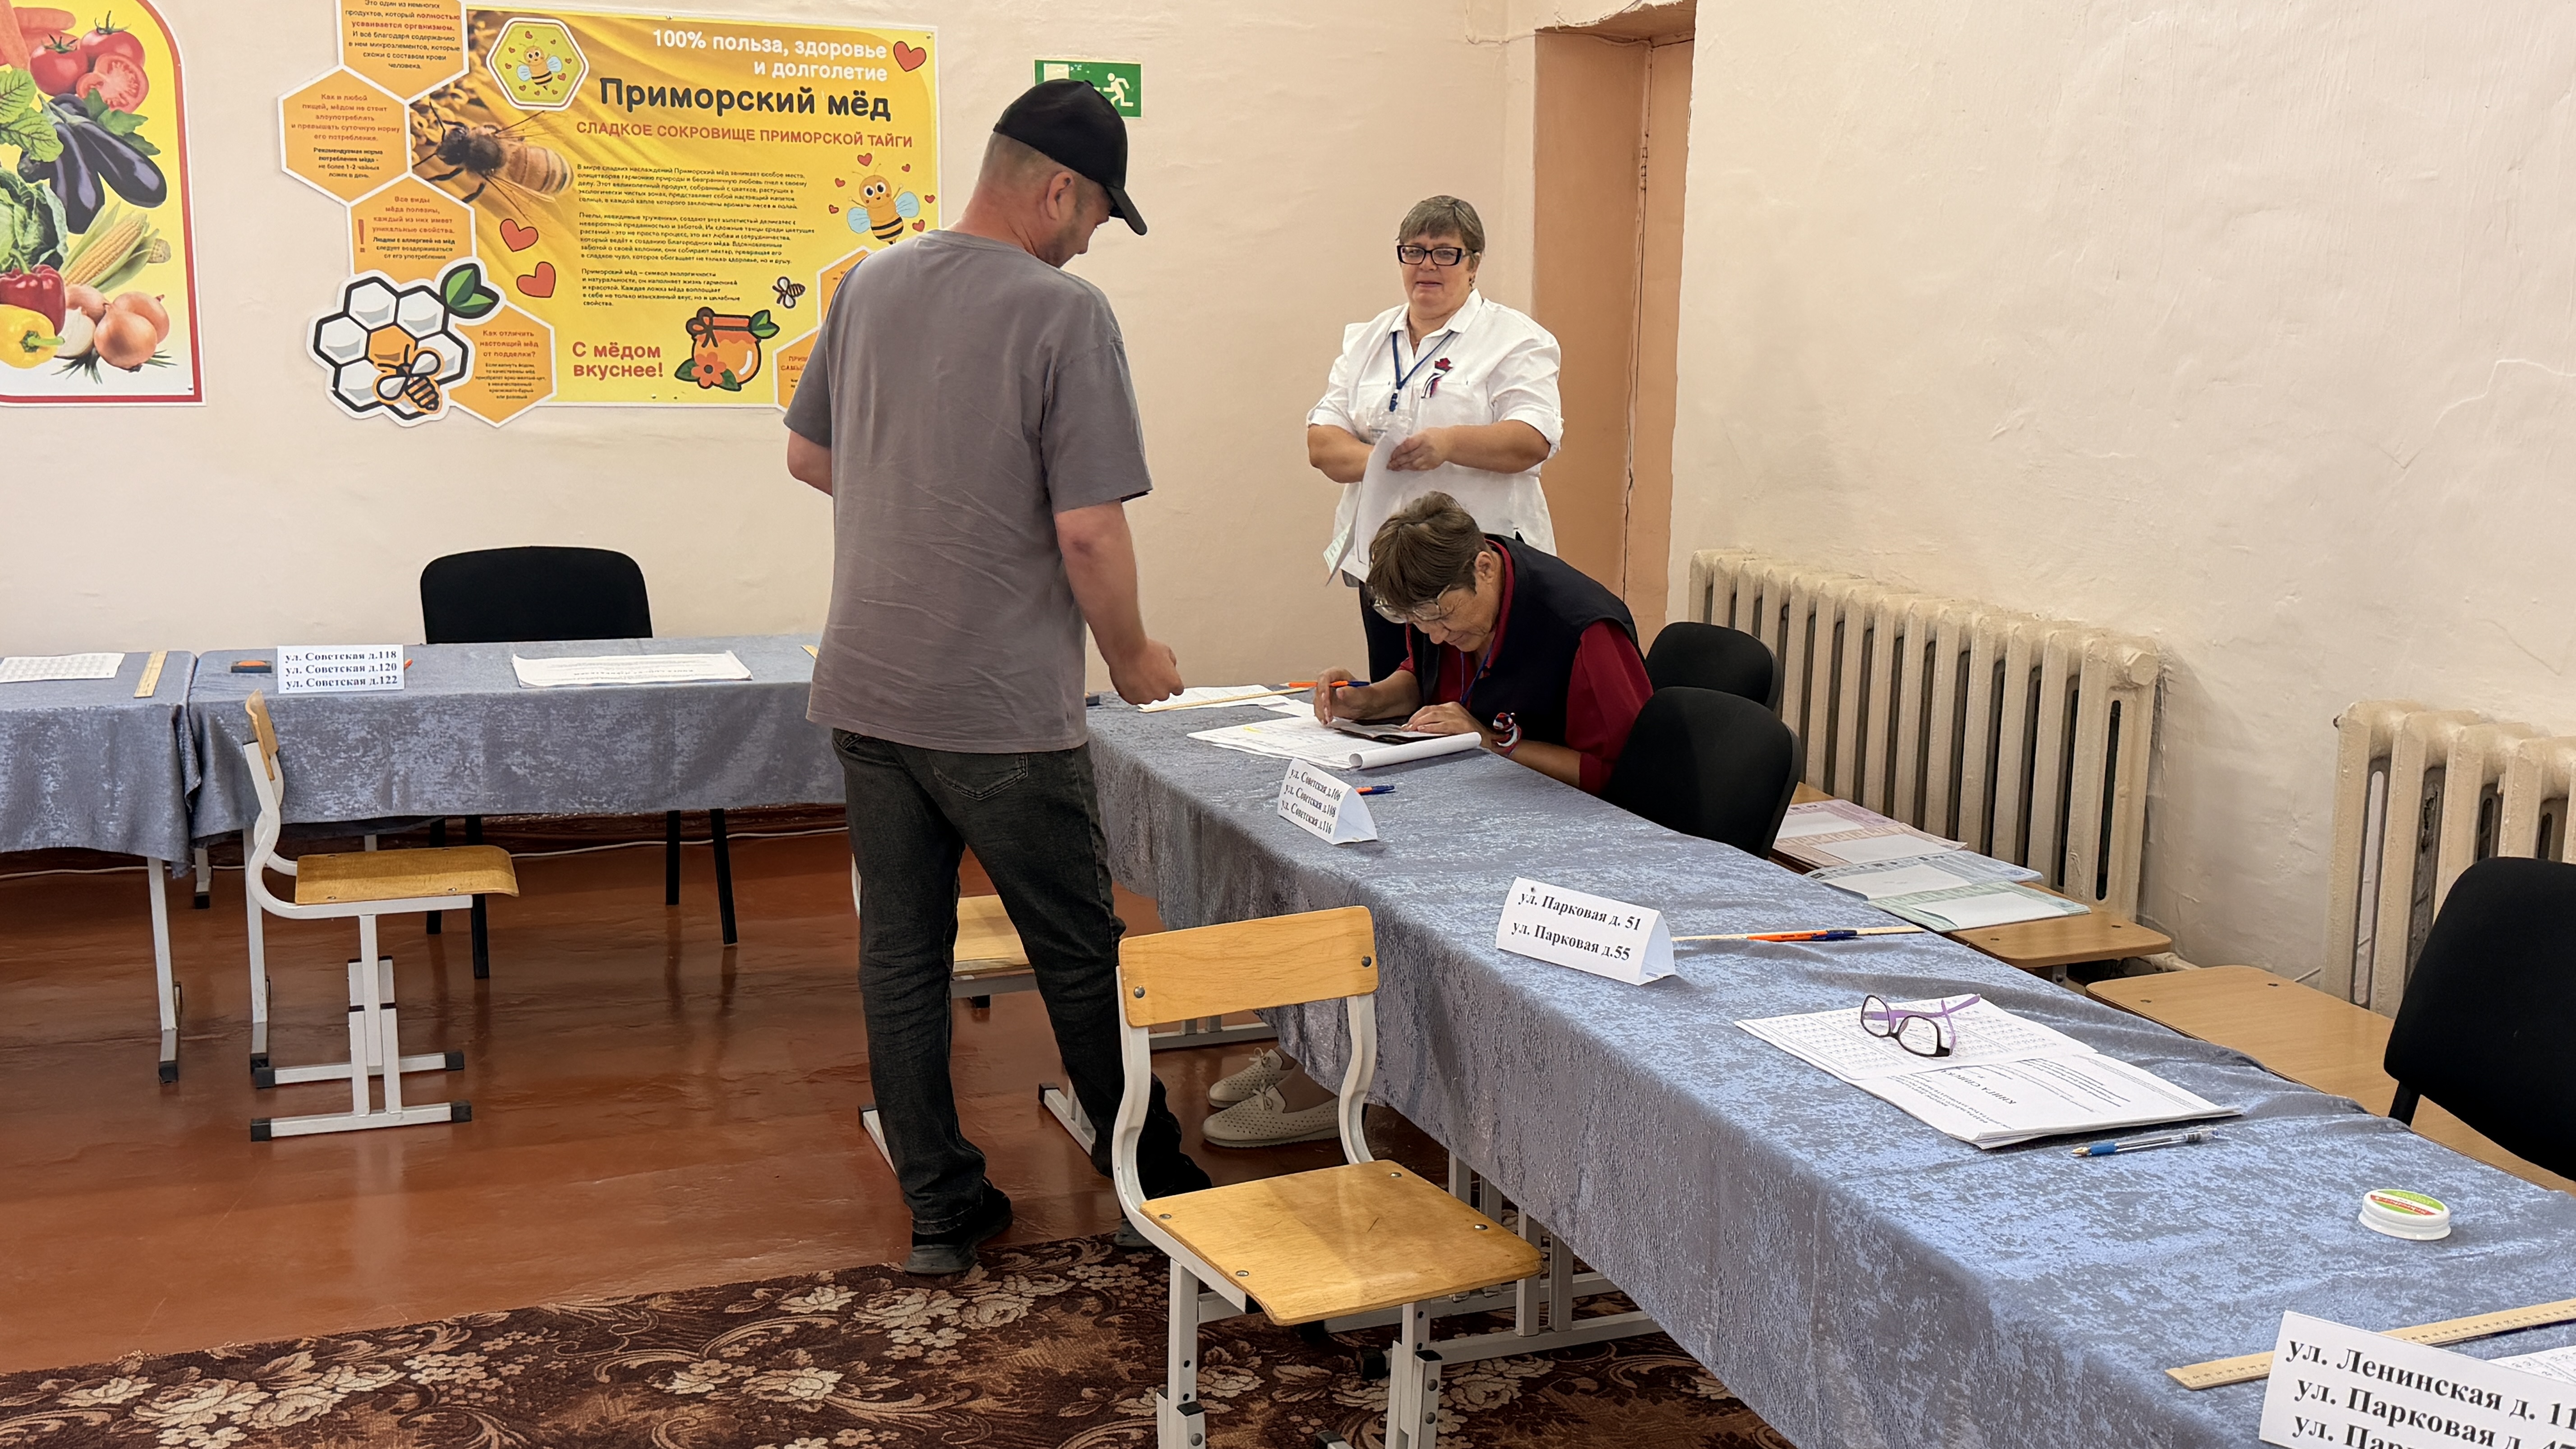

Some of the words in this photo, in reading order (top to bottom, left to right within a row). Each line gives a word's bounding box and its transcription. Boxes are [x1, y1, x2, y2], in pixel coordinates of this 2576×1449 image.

[653, 29, 706, 49] 100%
[713, 36, 789, 56] польза,
[795, 41, 887, 60] здоровье
[754, 61, 765, 75] и
[772, 62, 888, 82] долголетие
[599, 77, 815, 117] Приморский
[828, 90, 891, 122] мёд
[576, 121, 653, 138] СЛАДКОЕ
[657, 125, 755, 143] СОКРОВИЩЕ
[760, 129, 863, 146] ПРИМОРСКОЙ
[867, 133, 912, 148] ТАЙГИ
[572, 341, 586, 357] С
[593, 342, 661, 360] мёдом
[573, 362, 663, 381] вкуснее!
[285, 655, 302, 663] ул.
[305, 653, 365, 661] Советская
[368, 651, 396, 660] д.118
[285, 667, 302, 677] ул.
[305, 665, 365, 674] Советская
[368, 662, 397, 672] д.120
[286, 681, 303, 690] ул.
[306, 678, 366, 687] Советская
[369, 675, 397, 685] д.122
[1289, 769, 1299, 779] ул.
[1284, 785, 1294, 794] ул.
[1281, 800, 1289, 810] ул.
[1518, 893, 1537, 906] ул.
[1541, 895, 1608, 922] Парковая
[1608, 915, 1620, 927] д.
[1625, 916, 1641, 930] 51
[1511, 922, 1530, 935] ул.
[1534, 925, 1599, 953] Парковая
[1601, 946, 1631, 961] д.55
[2286, 1340, 2328, 1365] ул.
[2337, 1348, 2503, 1411] Ленинская
[2509, 1399, 2535, 1420] д.
[2294, 1380, 2336, 1405] ул.
[2346, 1387, 2496, 1446] Парковая
[2292, 1416, 2333, 1441] ул.
